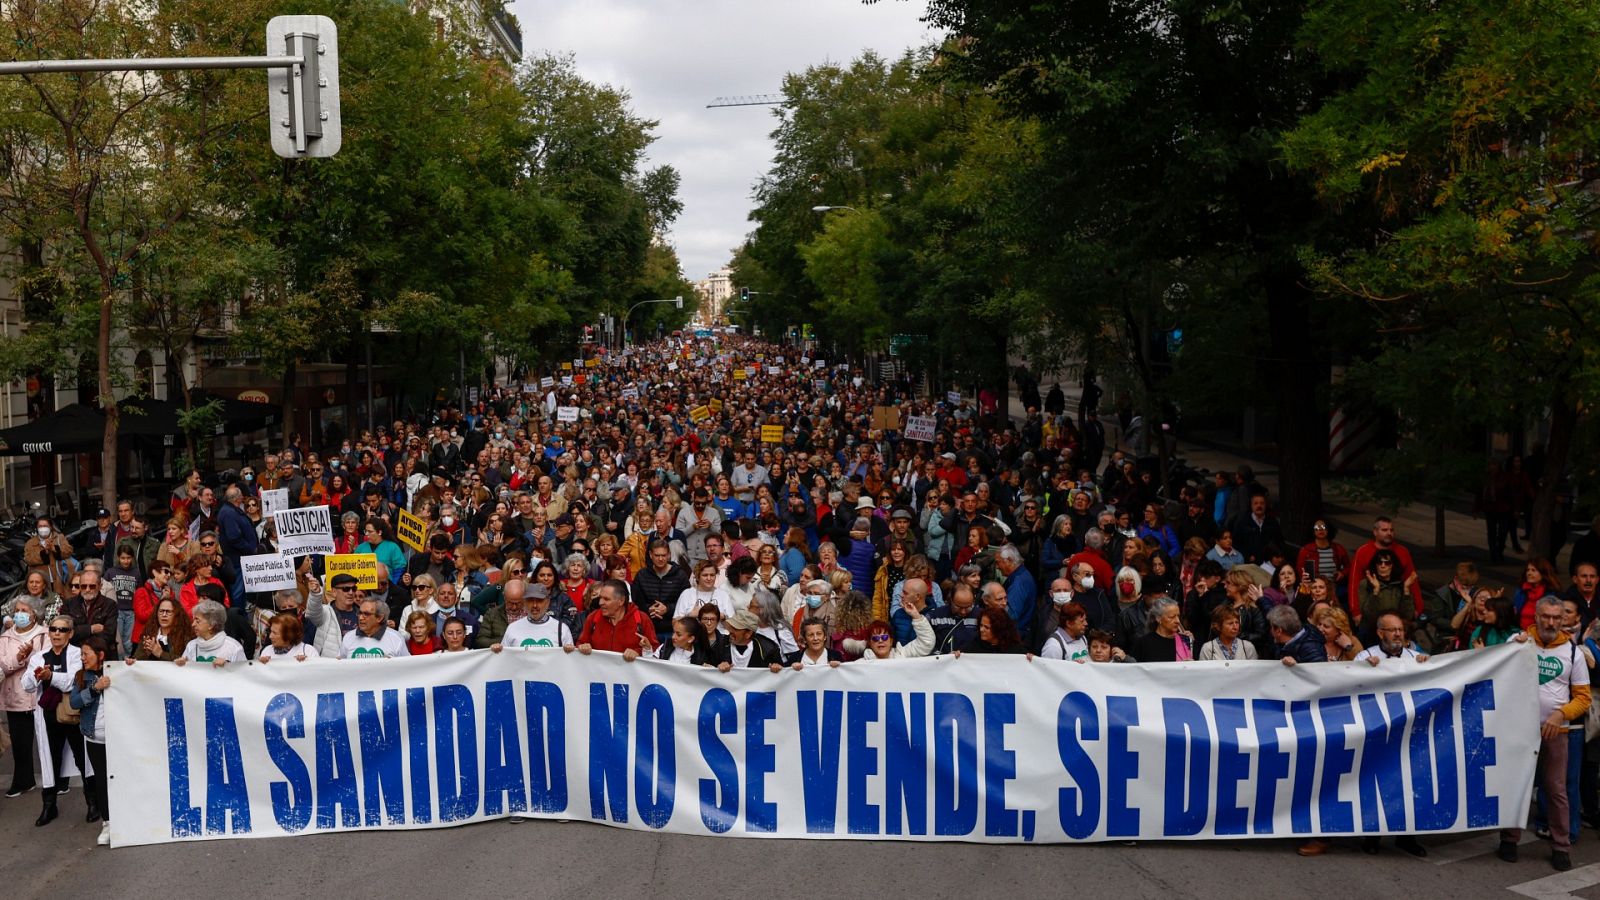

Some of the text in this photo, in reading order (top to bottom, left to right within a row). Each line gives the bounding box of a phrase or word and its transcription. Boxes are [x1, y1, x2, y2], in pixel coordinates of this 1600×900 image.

[22, 441, 52, 454] GOIKO
[276, 510, 330, 535] ¡JUSTICIA!
[245, 562, 264, 572] Sanidad
[245, 576, 254, 586] Ley
[164, 679, 1499, 842] LA SANIDAD NO SE VENDE, SE DEFIENDE
